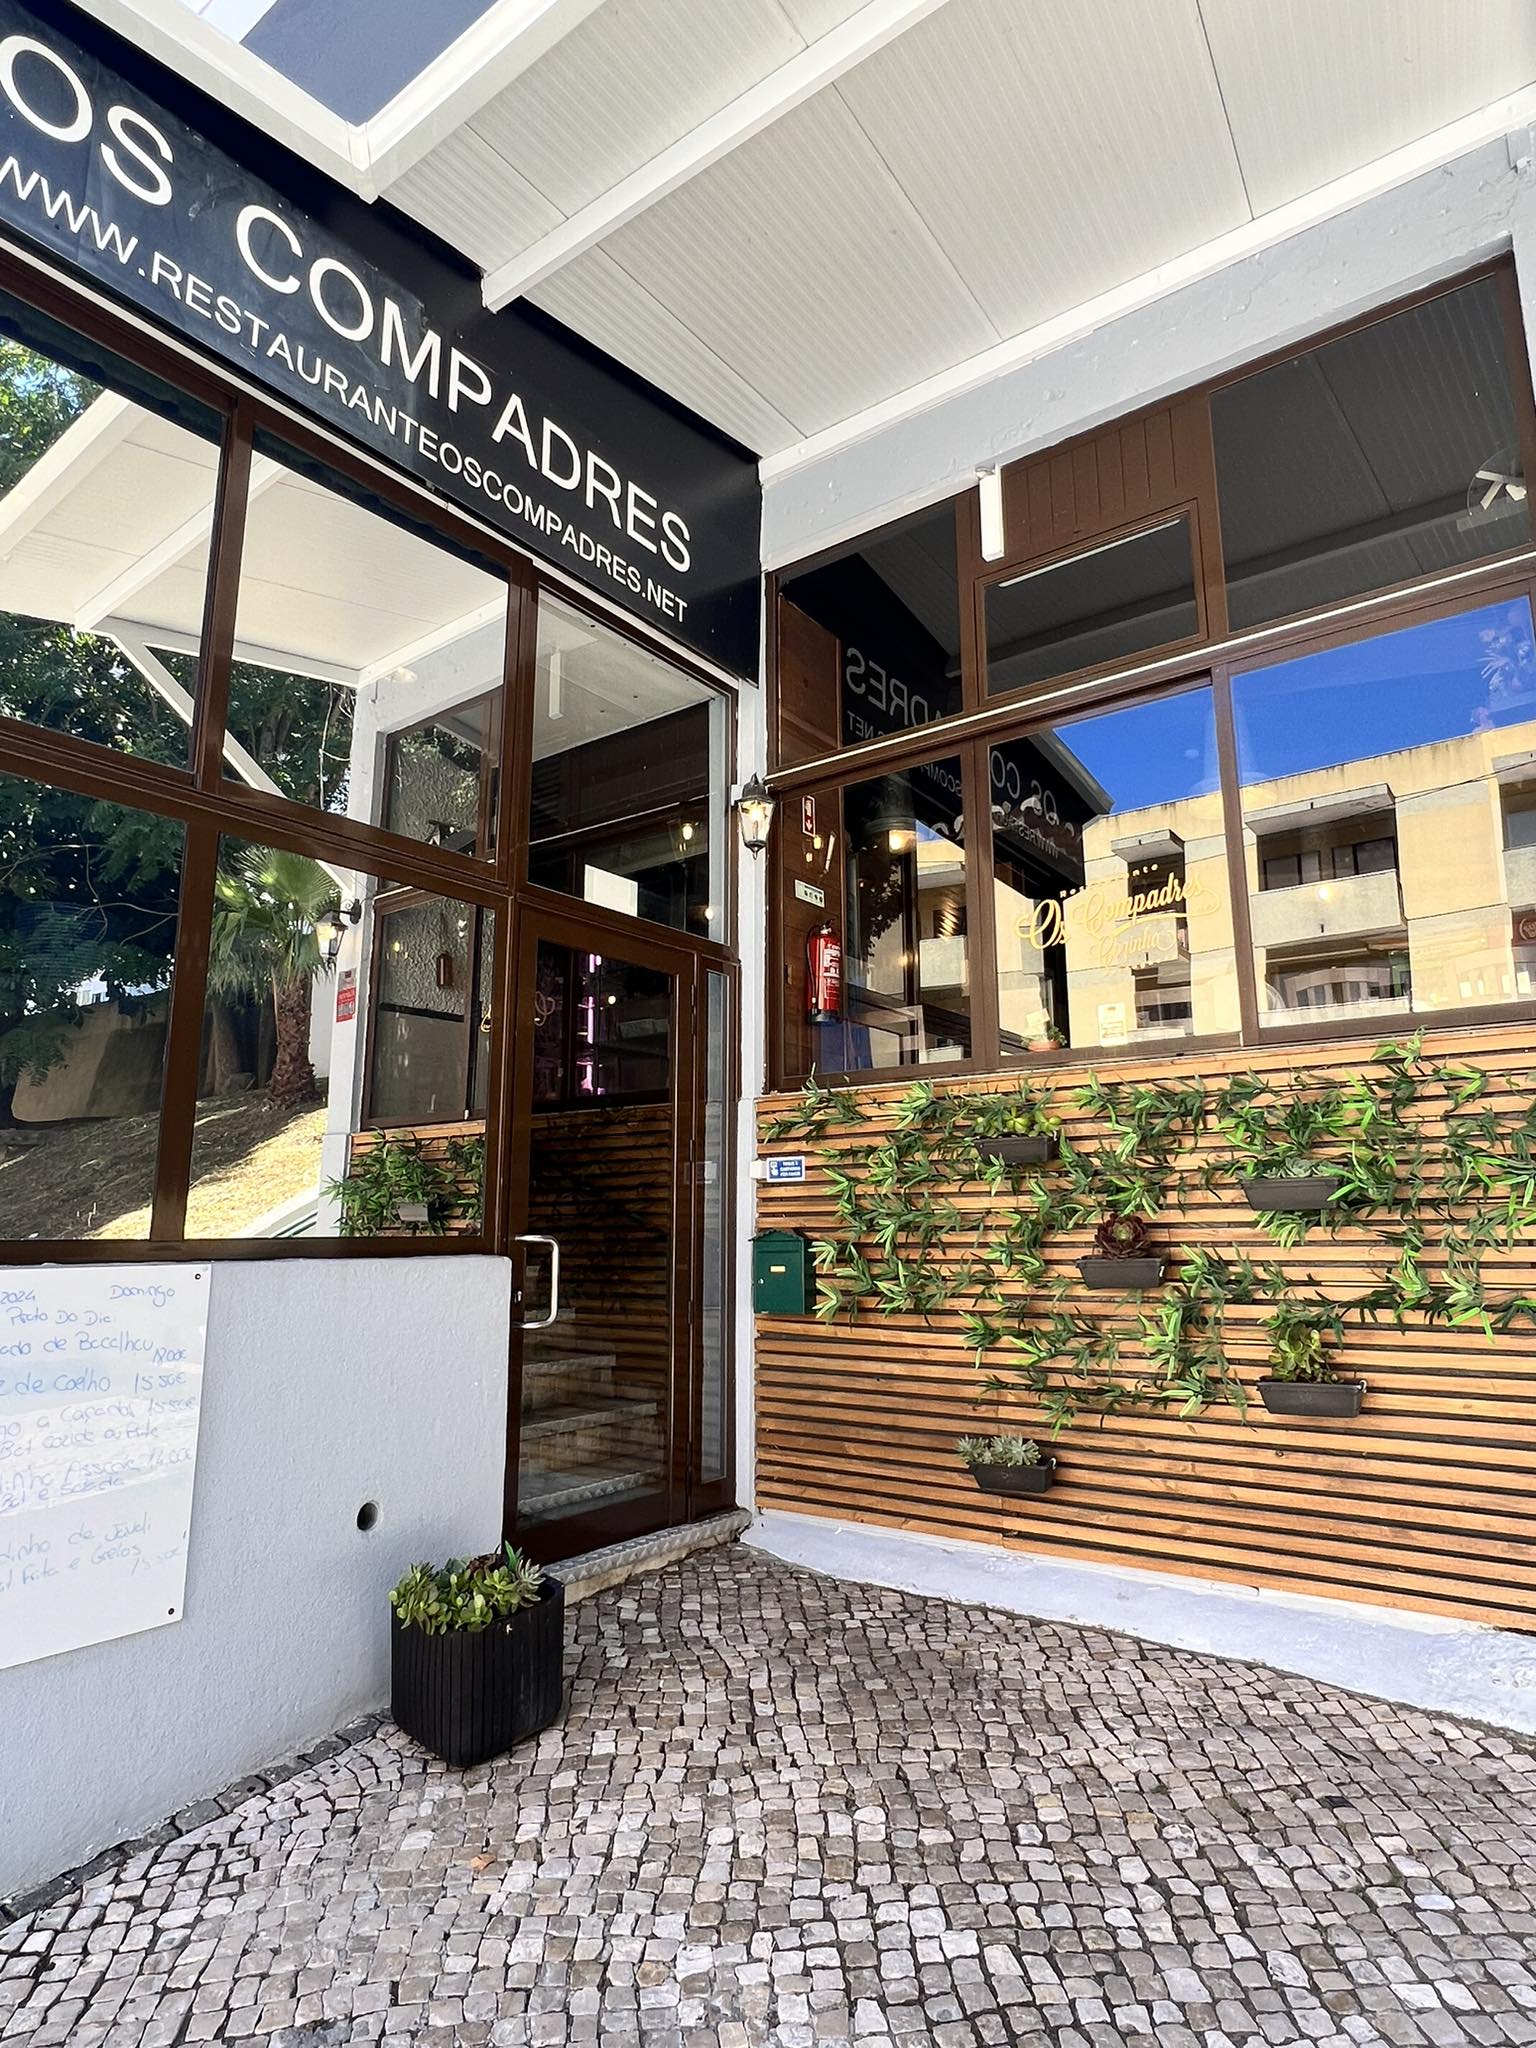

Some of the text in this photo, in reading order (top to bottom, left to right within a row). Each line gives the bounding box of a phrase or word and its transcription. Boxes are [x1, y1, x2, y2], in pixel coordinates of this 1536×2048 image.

[1, 35, 692, 573] OS COMPADRES
[1072, 871, 1220, 940] Compadres
[109, 1284, 176, 1308] Domingo
[55, 1309, 79, 1325] Do
[43, 1336, 68, 1353] de
[75, 1330, 154, 1352] Bacalhau
[15, 1371, 45, 1394] de
[53, 1367, 111, 1392] Coelho
